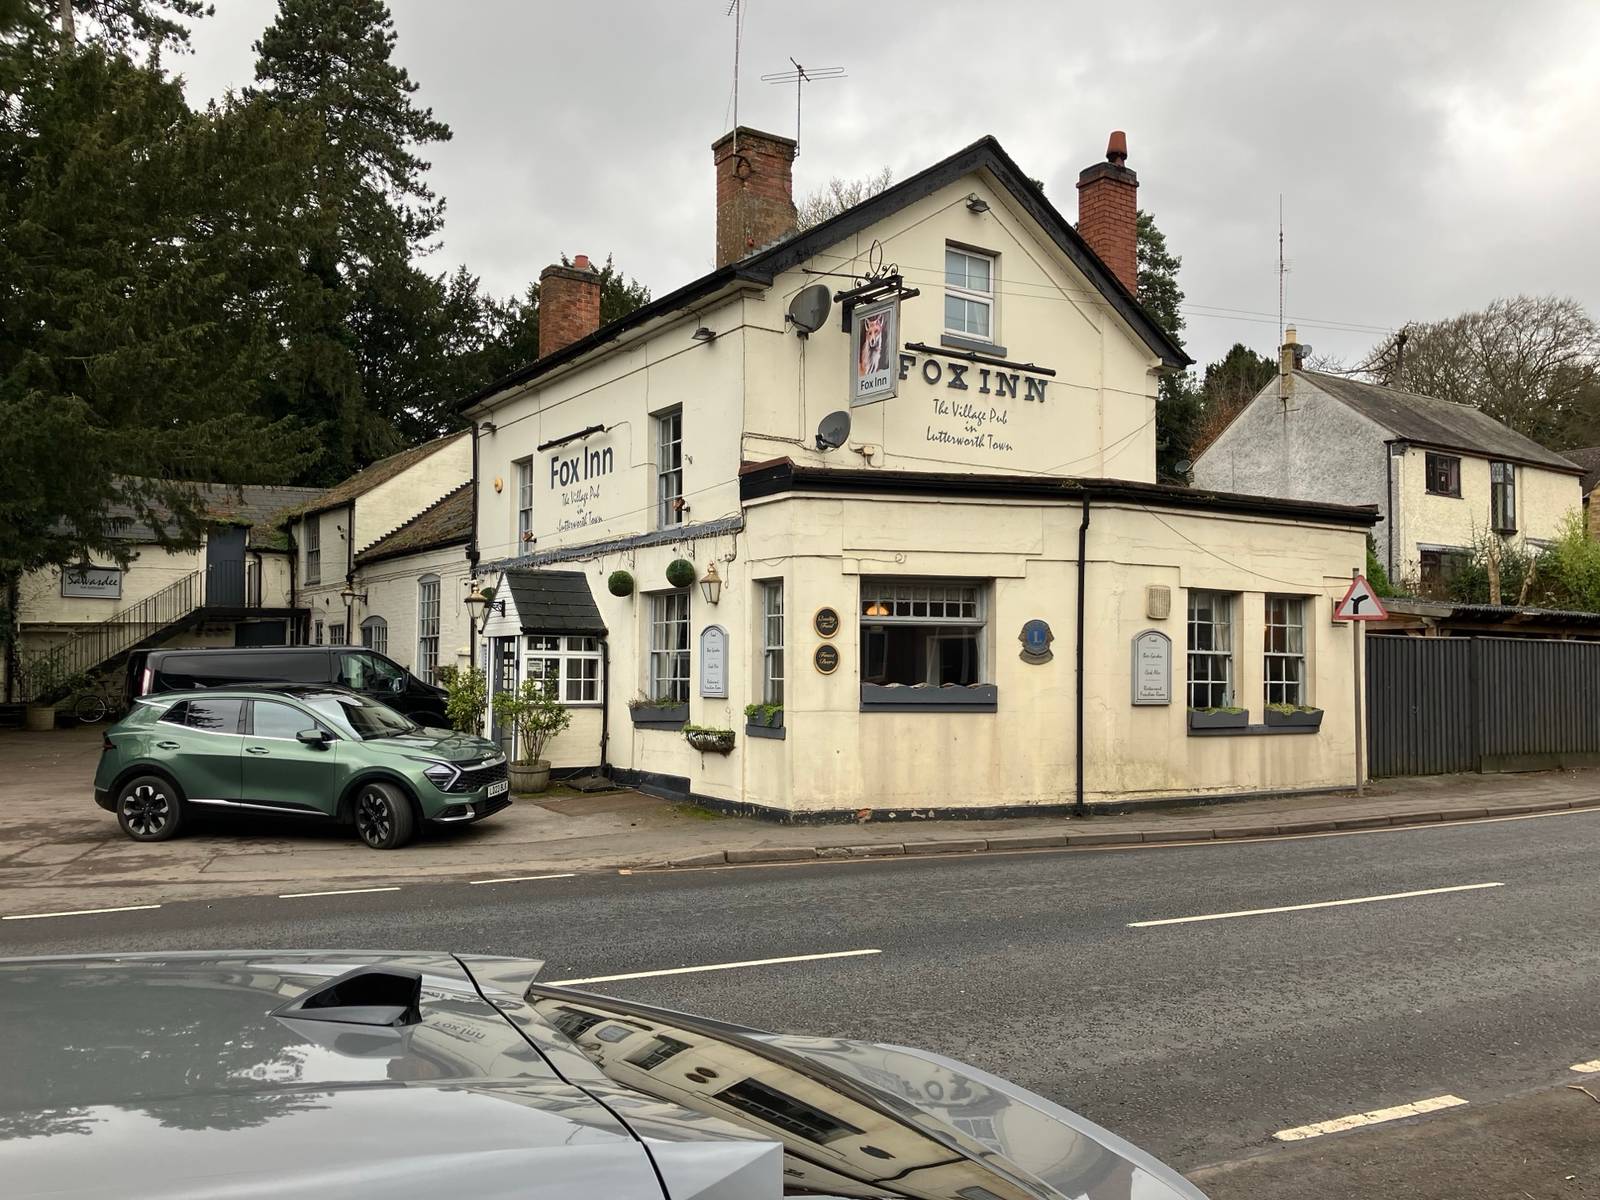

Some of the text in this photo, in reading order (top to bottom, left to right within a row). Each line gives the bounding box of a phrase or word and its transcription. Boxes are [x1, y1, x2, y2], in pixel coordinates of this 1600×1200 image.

[860, 376, 886, 390] Fox Inn
[899, 354, 1048, 403] FOX INN
[933, 398, 1008, 426] The Village Pub
[926, 426, 1013, 452] Lutterworth Town
[964, 421, 978, 432] in
[551, 446, 613, 490] Fox Inn
